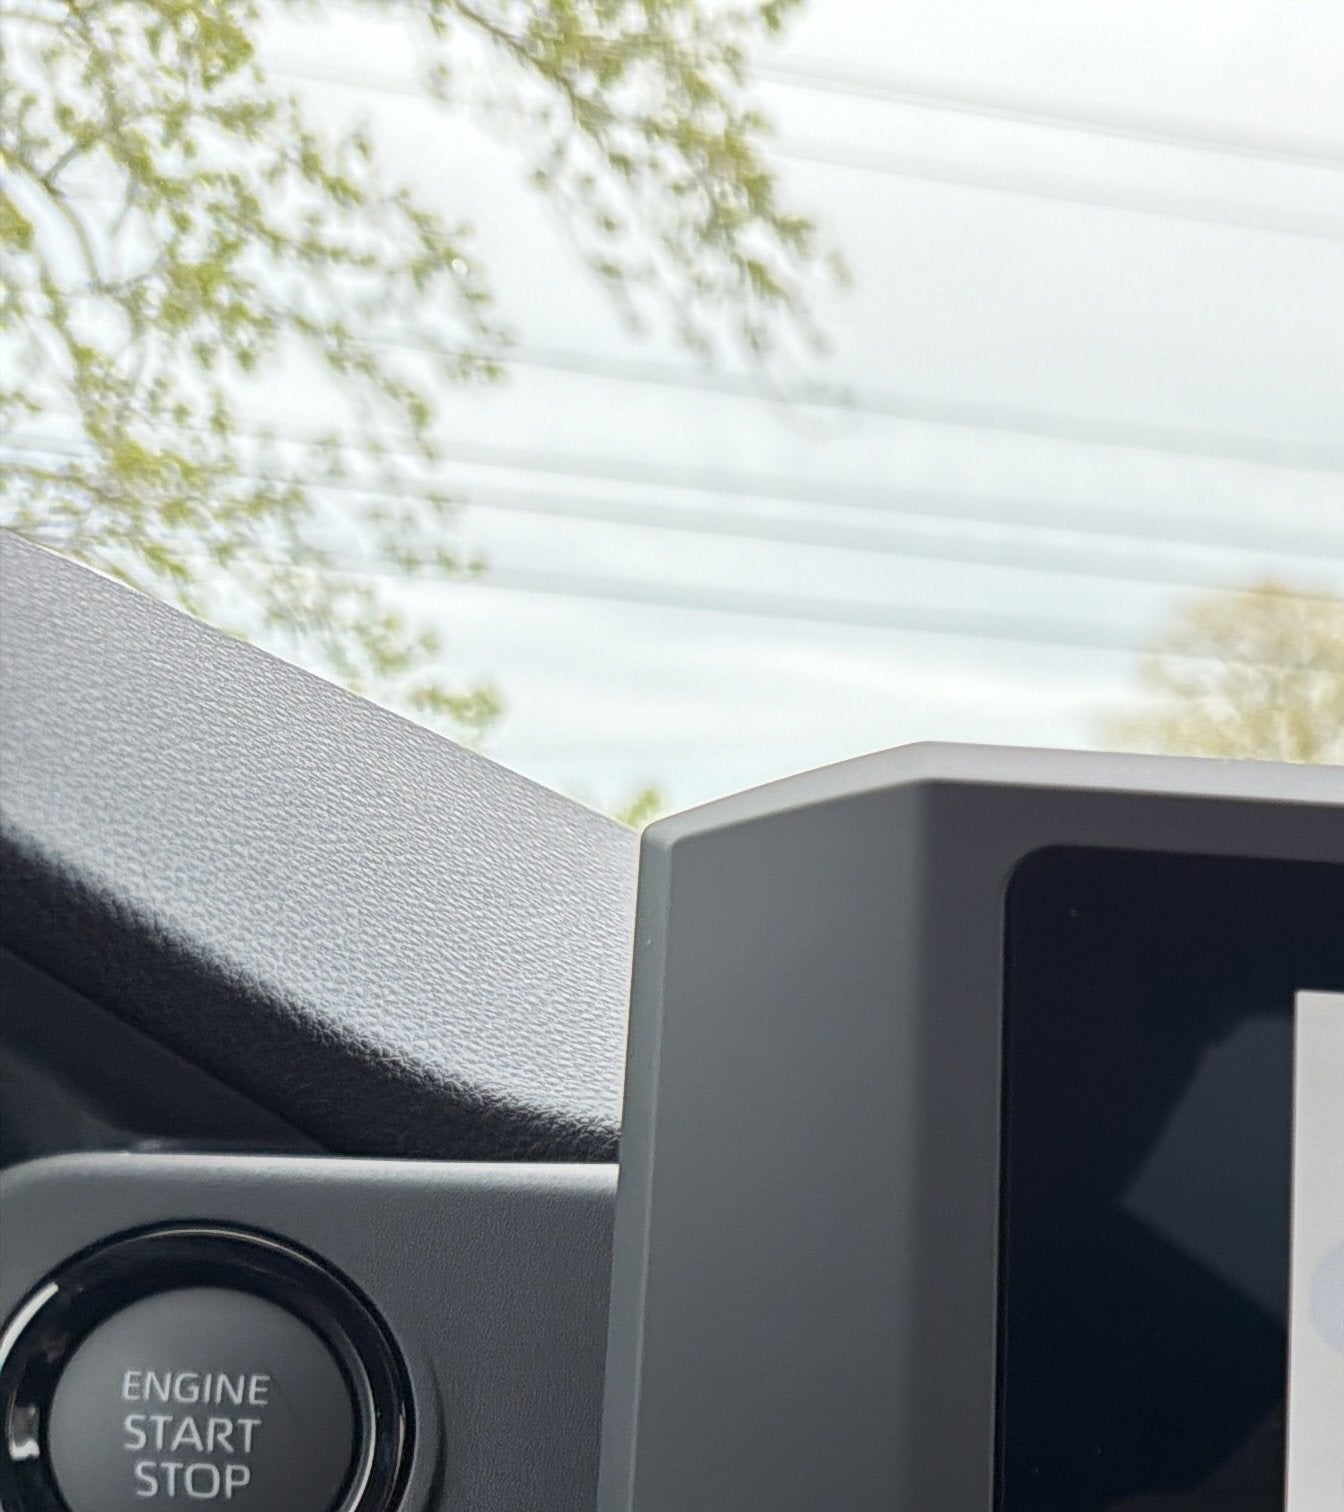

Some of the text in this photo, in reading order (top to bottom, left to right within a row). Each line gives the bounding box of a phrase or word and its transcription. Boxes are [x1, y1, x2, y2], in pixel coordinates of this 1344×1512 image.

[122, 1370, 271, 1406] ENGINE
[123, 1414, 262, 1453] START
[134, 1461, 251, 1499] STOP
